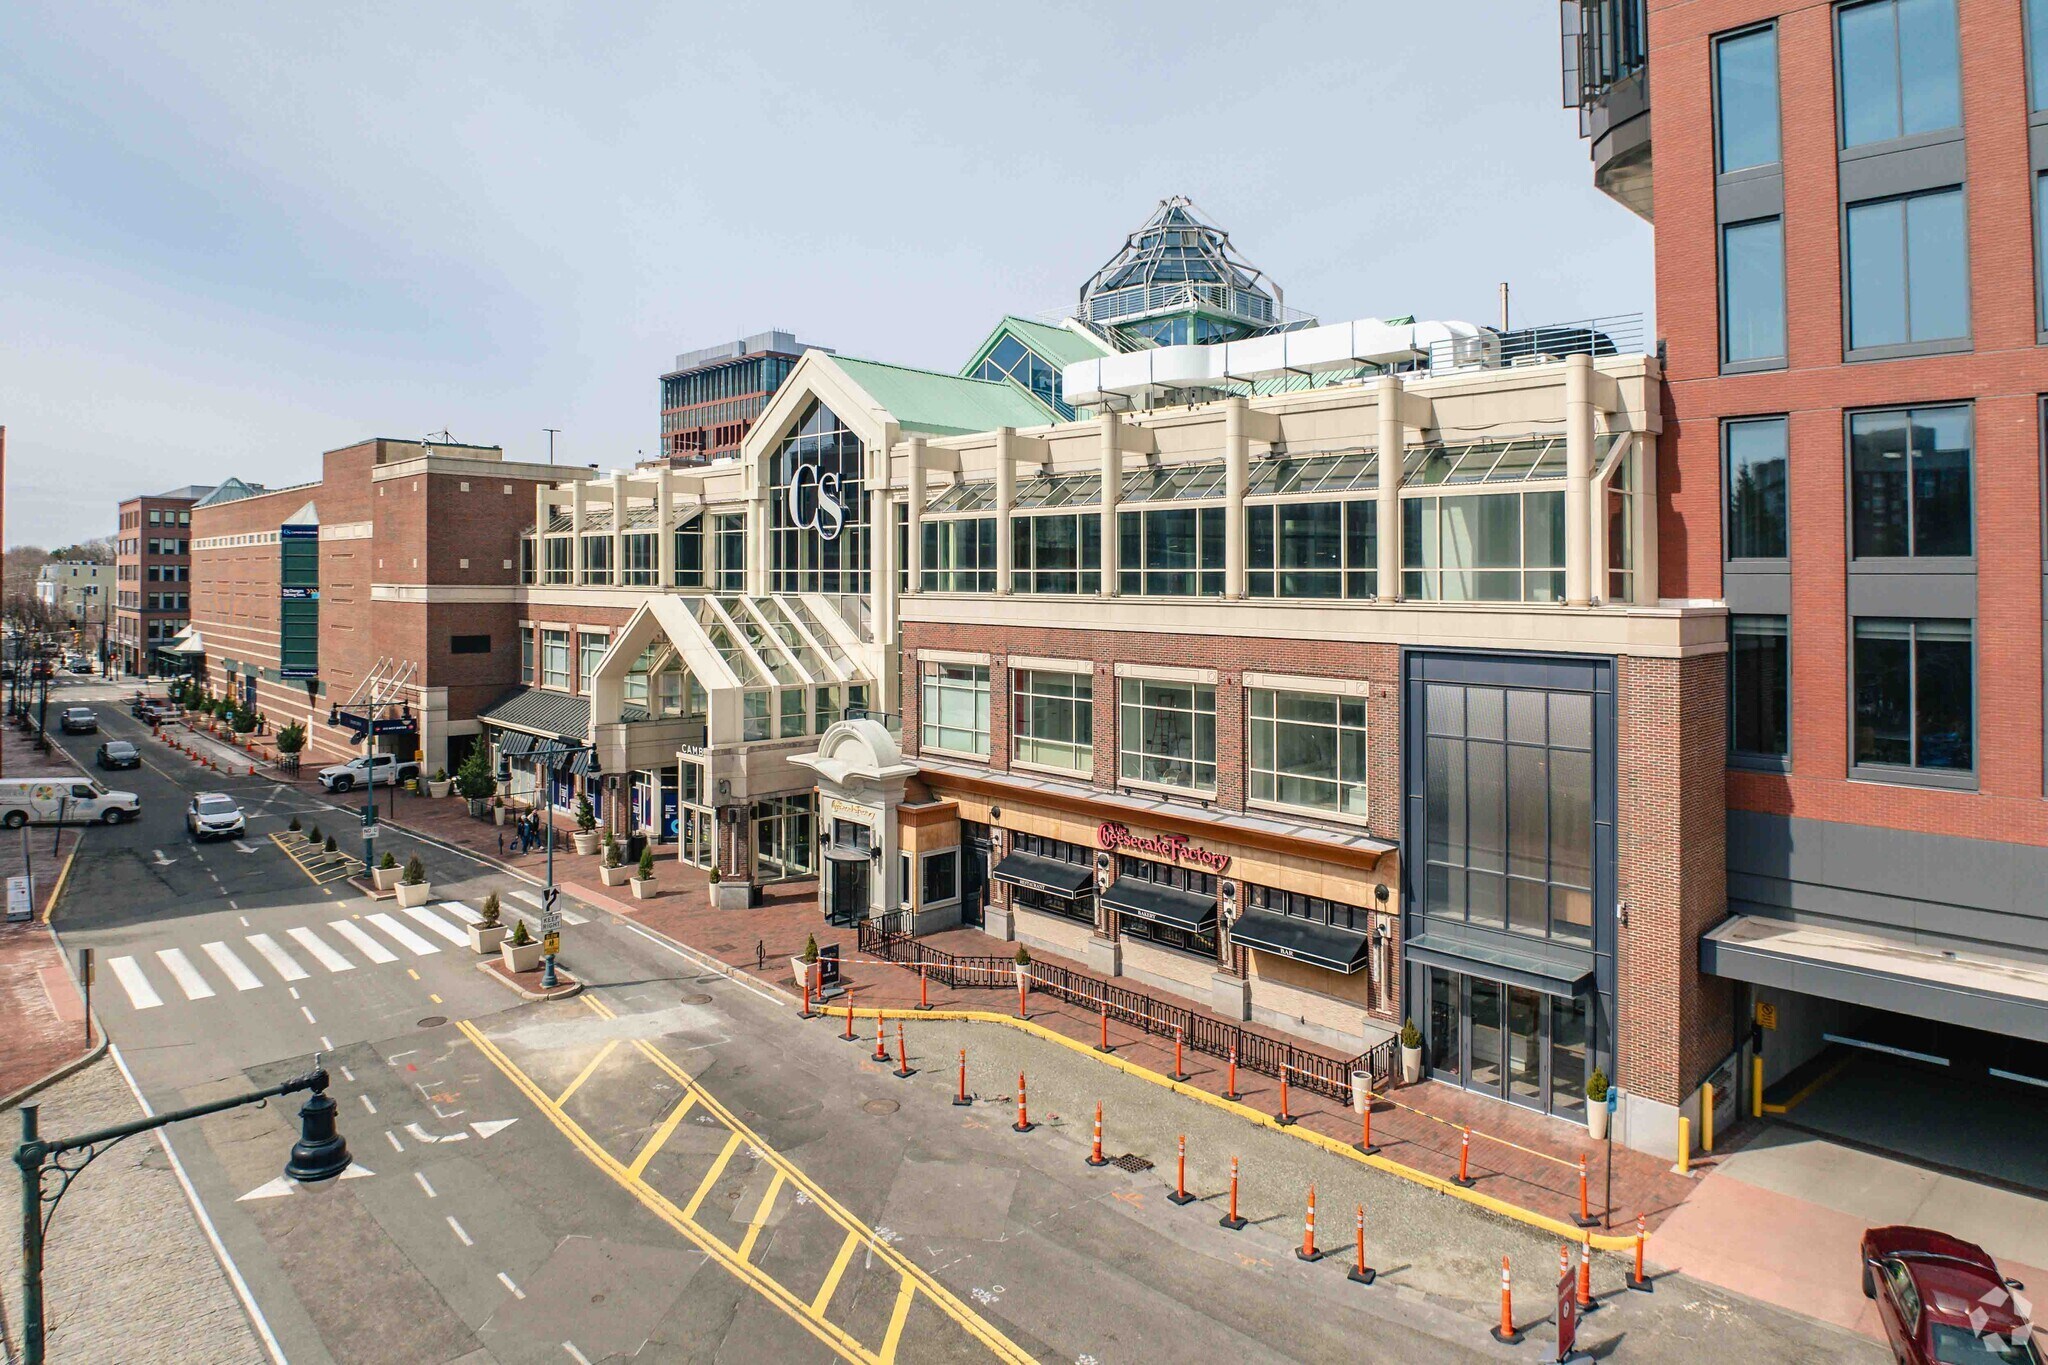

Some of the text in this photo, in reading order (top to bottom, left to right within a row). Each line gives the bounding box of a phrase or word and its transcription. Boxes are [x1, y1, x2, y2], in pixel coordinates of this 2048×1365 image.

[789, 463, 843, 540] CS
[1097, 822, 1228, 872] Cheesecake Factory
[1280, 947, 1294, 957] BAR
